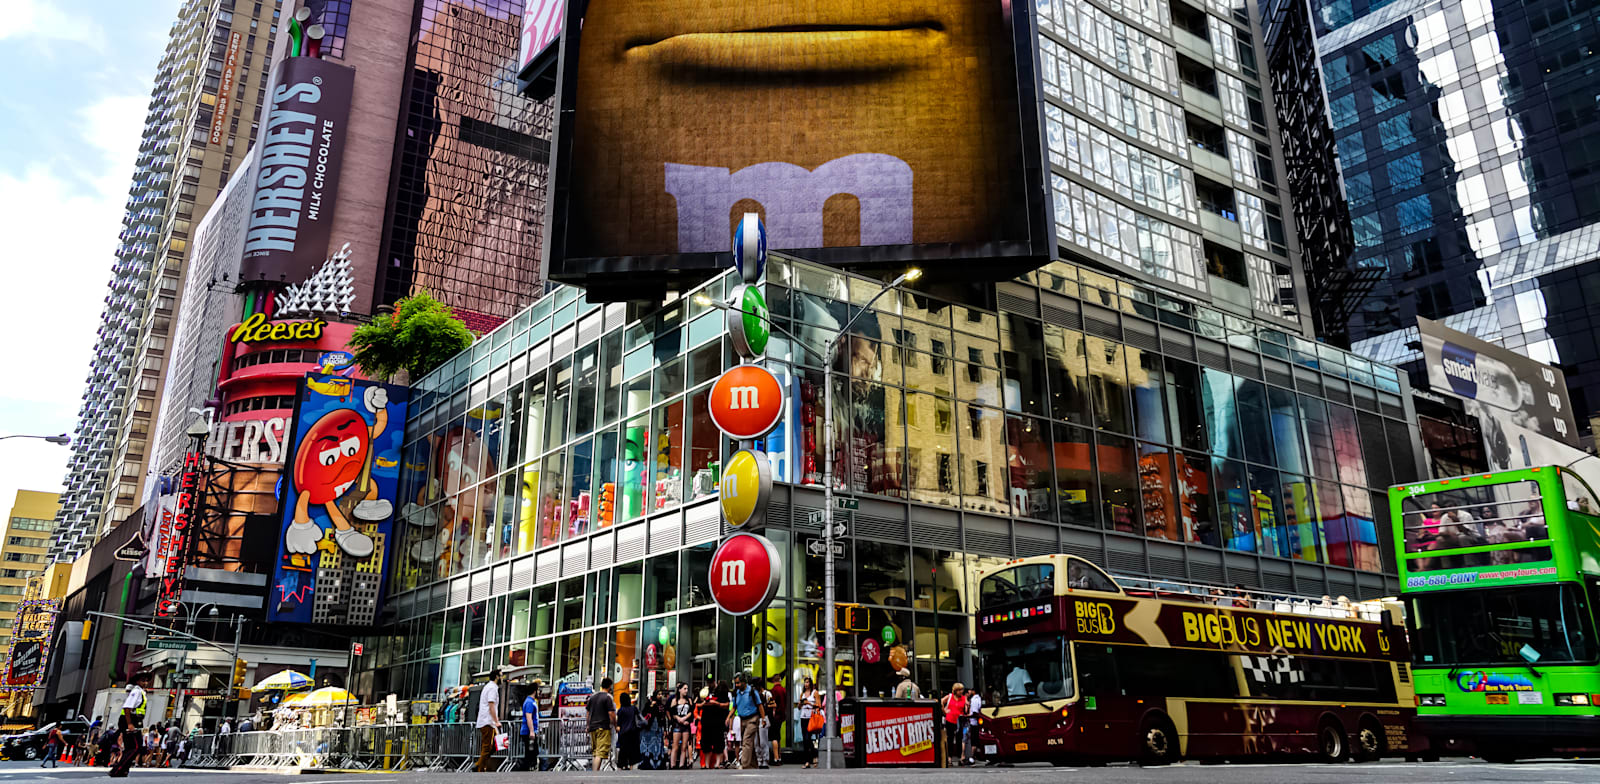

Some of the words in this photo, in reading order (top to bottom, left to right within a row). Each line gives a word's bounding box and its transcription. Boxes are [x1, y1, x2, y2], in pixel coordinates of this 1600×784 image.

[313, 119, 334, 190] CHOCOLATE
[245, 82, 321, 252] HERSHEY'S
[308, 191, 322, 221] MILK
[1541, 367, 1556, 388] up
[729, 385, 760, 410] m
[1548, 391, 1562, 412] up
[1553, 416, 1568, 437] up
[722, 473, 738, 500] m
[1408, 485, 1426, 495] 304
[842, 499, 847, 509] 7
[721, 559, 746, 586] m
[1407, 572, 1478, 588] 888-680-GONY
[1478, 566, 1557, 580] www.gonytours.com
[1075, 601, 1097, 618] BIG
[1077, 618, 1099, 634] BUS
[1266, 619, 1312, 649] NEW
[1314, 622, 1367, 654] YORK
[158, 642, 187, 650] Broadway
[865, 723, 905, 754] JERSEY
[907, 719, 934, 745] BOYS
